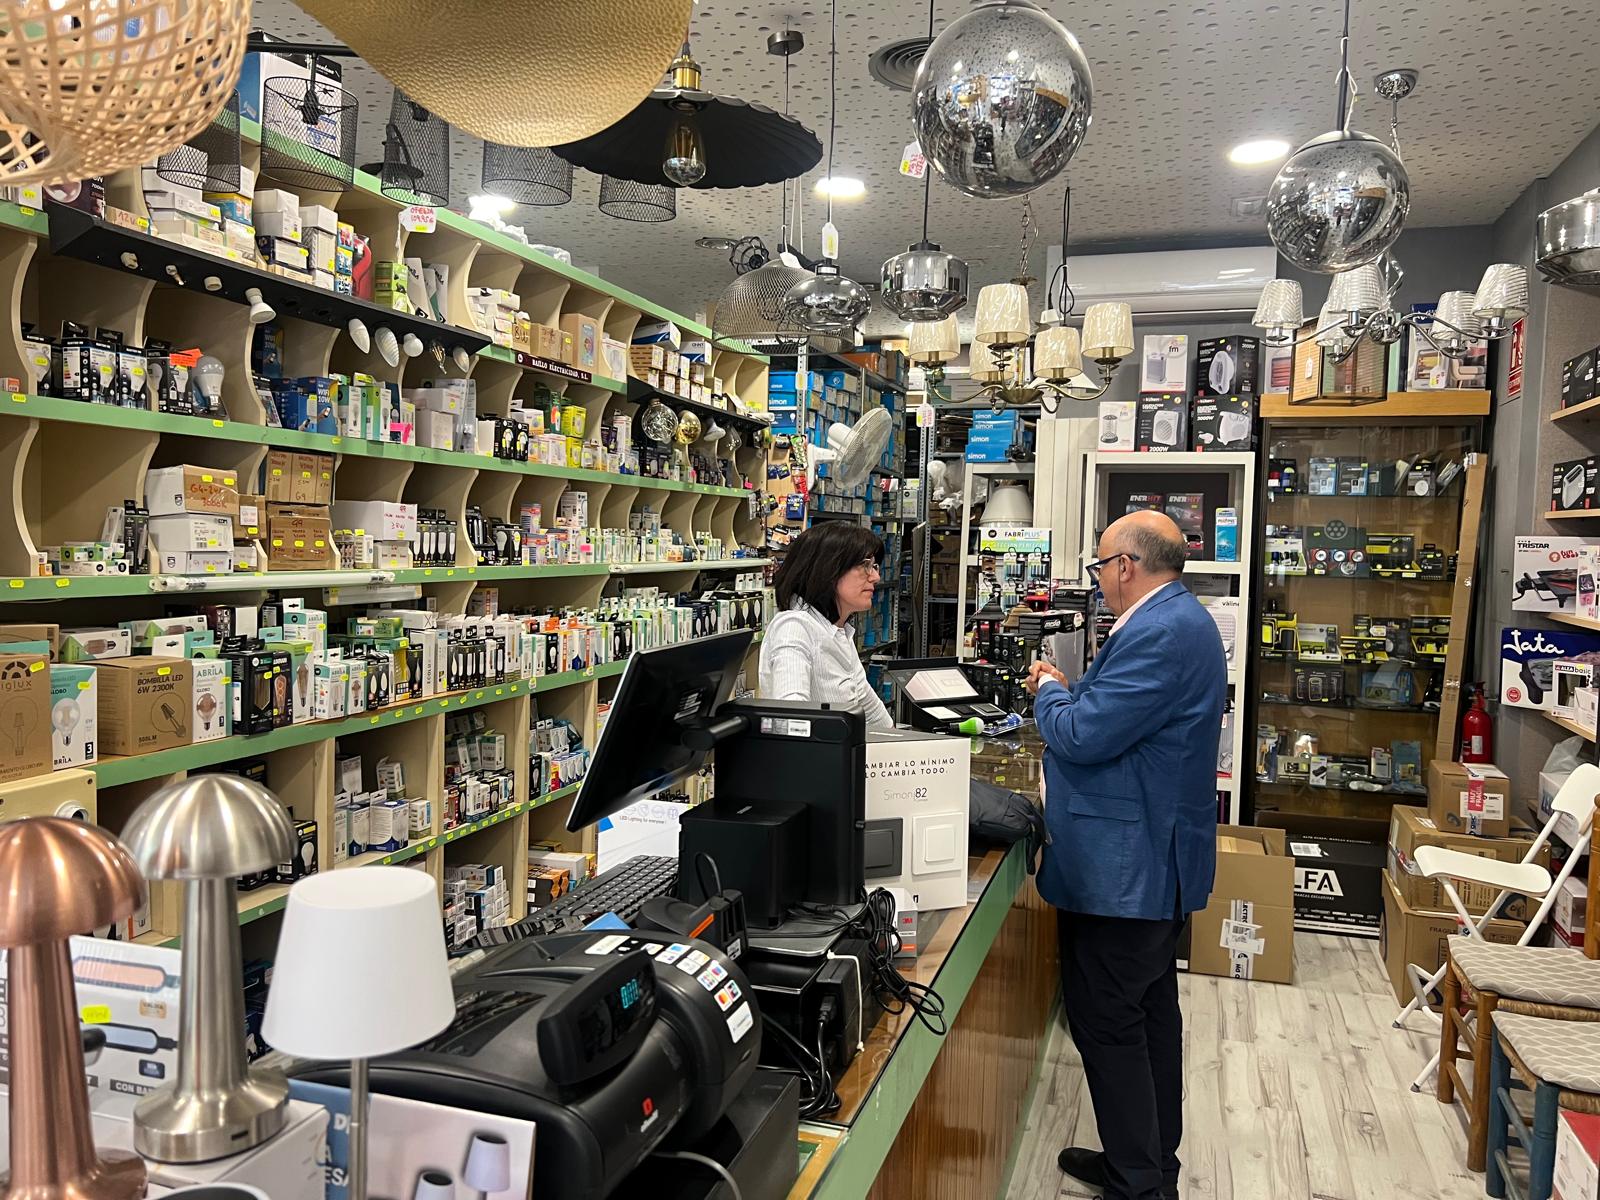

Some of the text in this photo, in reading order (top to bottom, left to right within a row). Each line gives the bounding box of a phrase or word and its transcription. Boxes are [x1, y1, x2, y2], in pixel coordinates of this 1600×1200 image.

[970, 435, 990, 443] simon
[967, 452, 986, 460] simon
[1502, 629, 1565, 655] Jata
[137, 674, 184, 686] BOMBILLA LED
[152, 683, 175, 693] 2300K
[881, 769, 916, 777] CAMBIA
[915, 787, 927, 798] 82
[115, 1082, 134, 1092] CON
